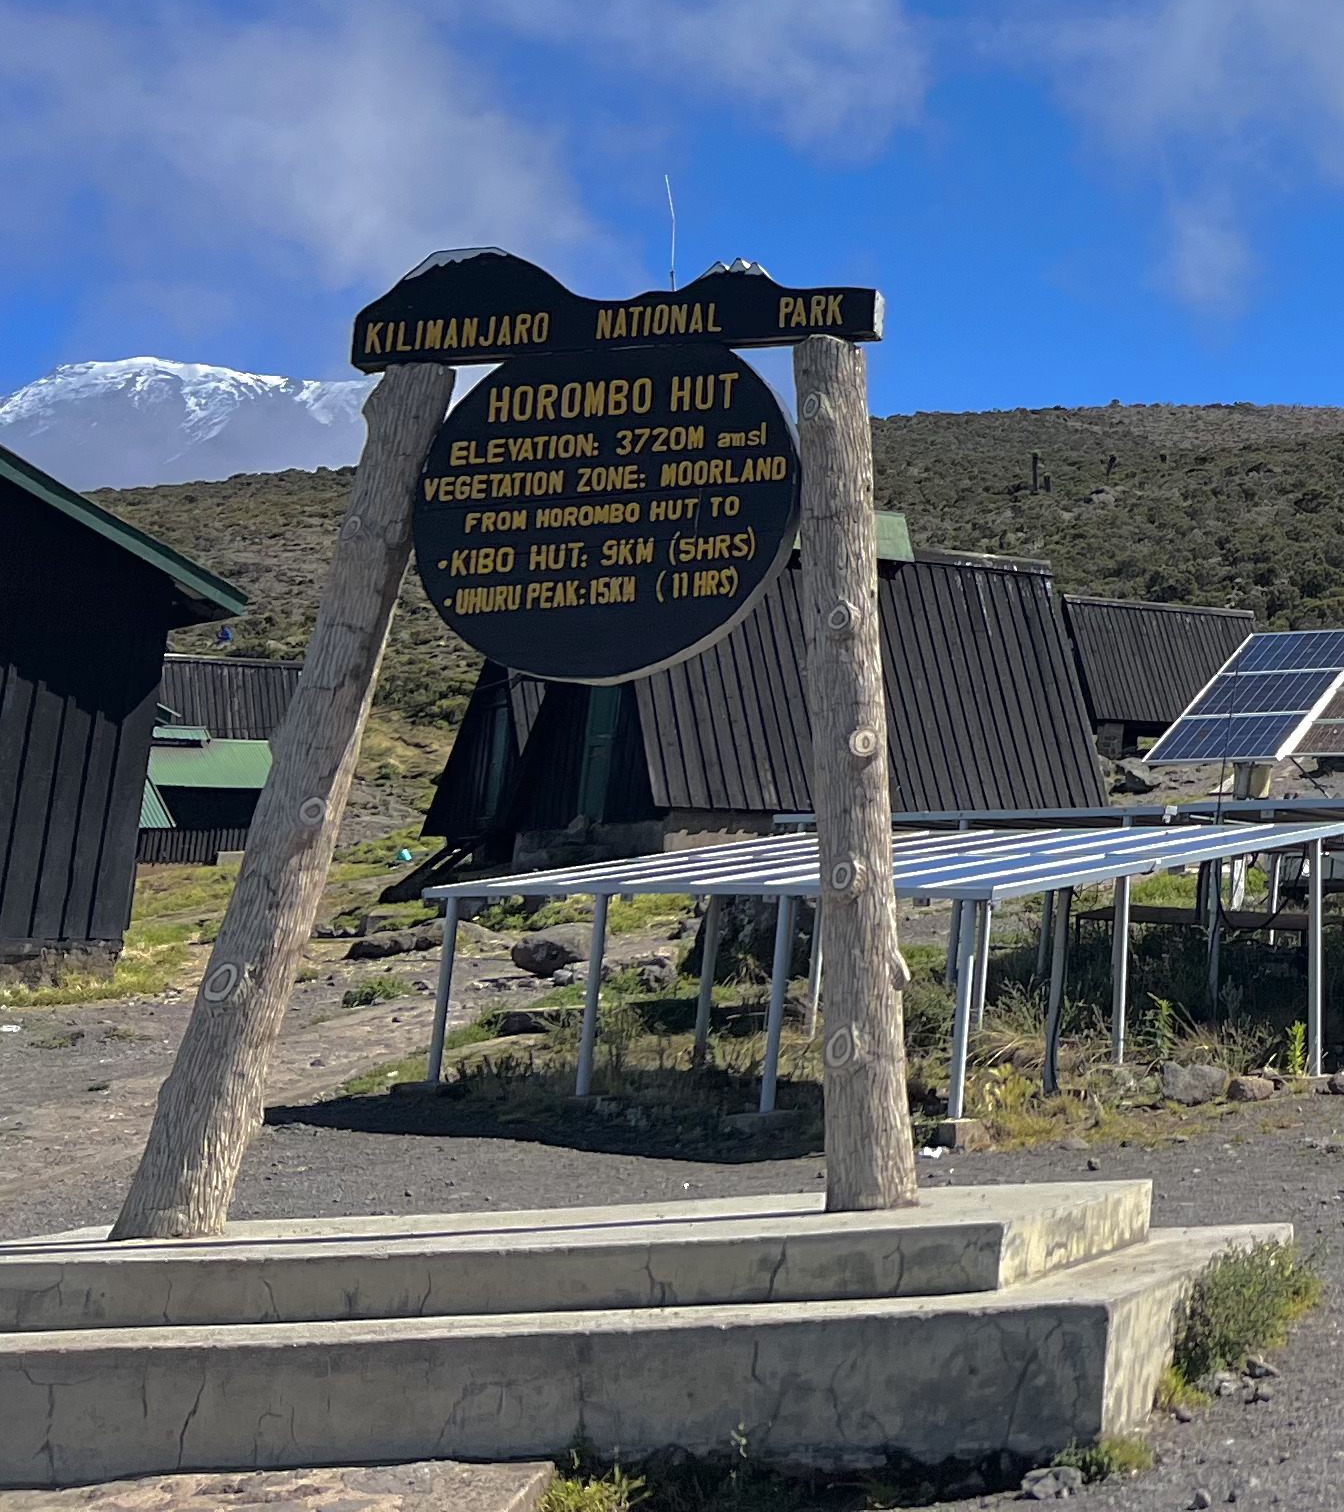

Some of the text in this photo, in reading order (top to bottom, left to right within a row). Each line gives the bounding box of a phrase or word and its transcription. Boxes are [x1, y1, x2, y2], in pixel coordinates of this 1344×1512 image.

[364, 294, 843, 354] KILIMANJARO NATIONAL PARK
[488, 373, 739, 423] HOROMBO HUT
[450, 422, 768, 466] ELEVATION: 3720M amsl
[424, 456, 786, 502] VEGETATION ZONE: MOORLAND
[464, 496, 740, 534] FROM HOROMBO HUT TO
[450, 526, 756, 577] KIBO HUT: 9KM (5HRS)
[455, 584, 522, 615] UHURU
